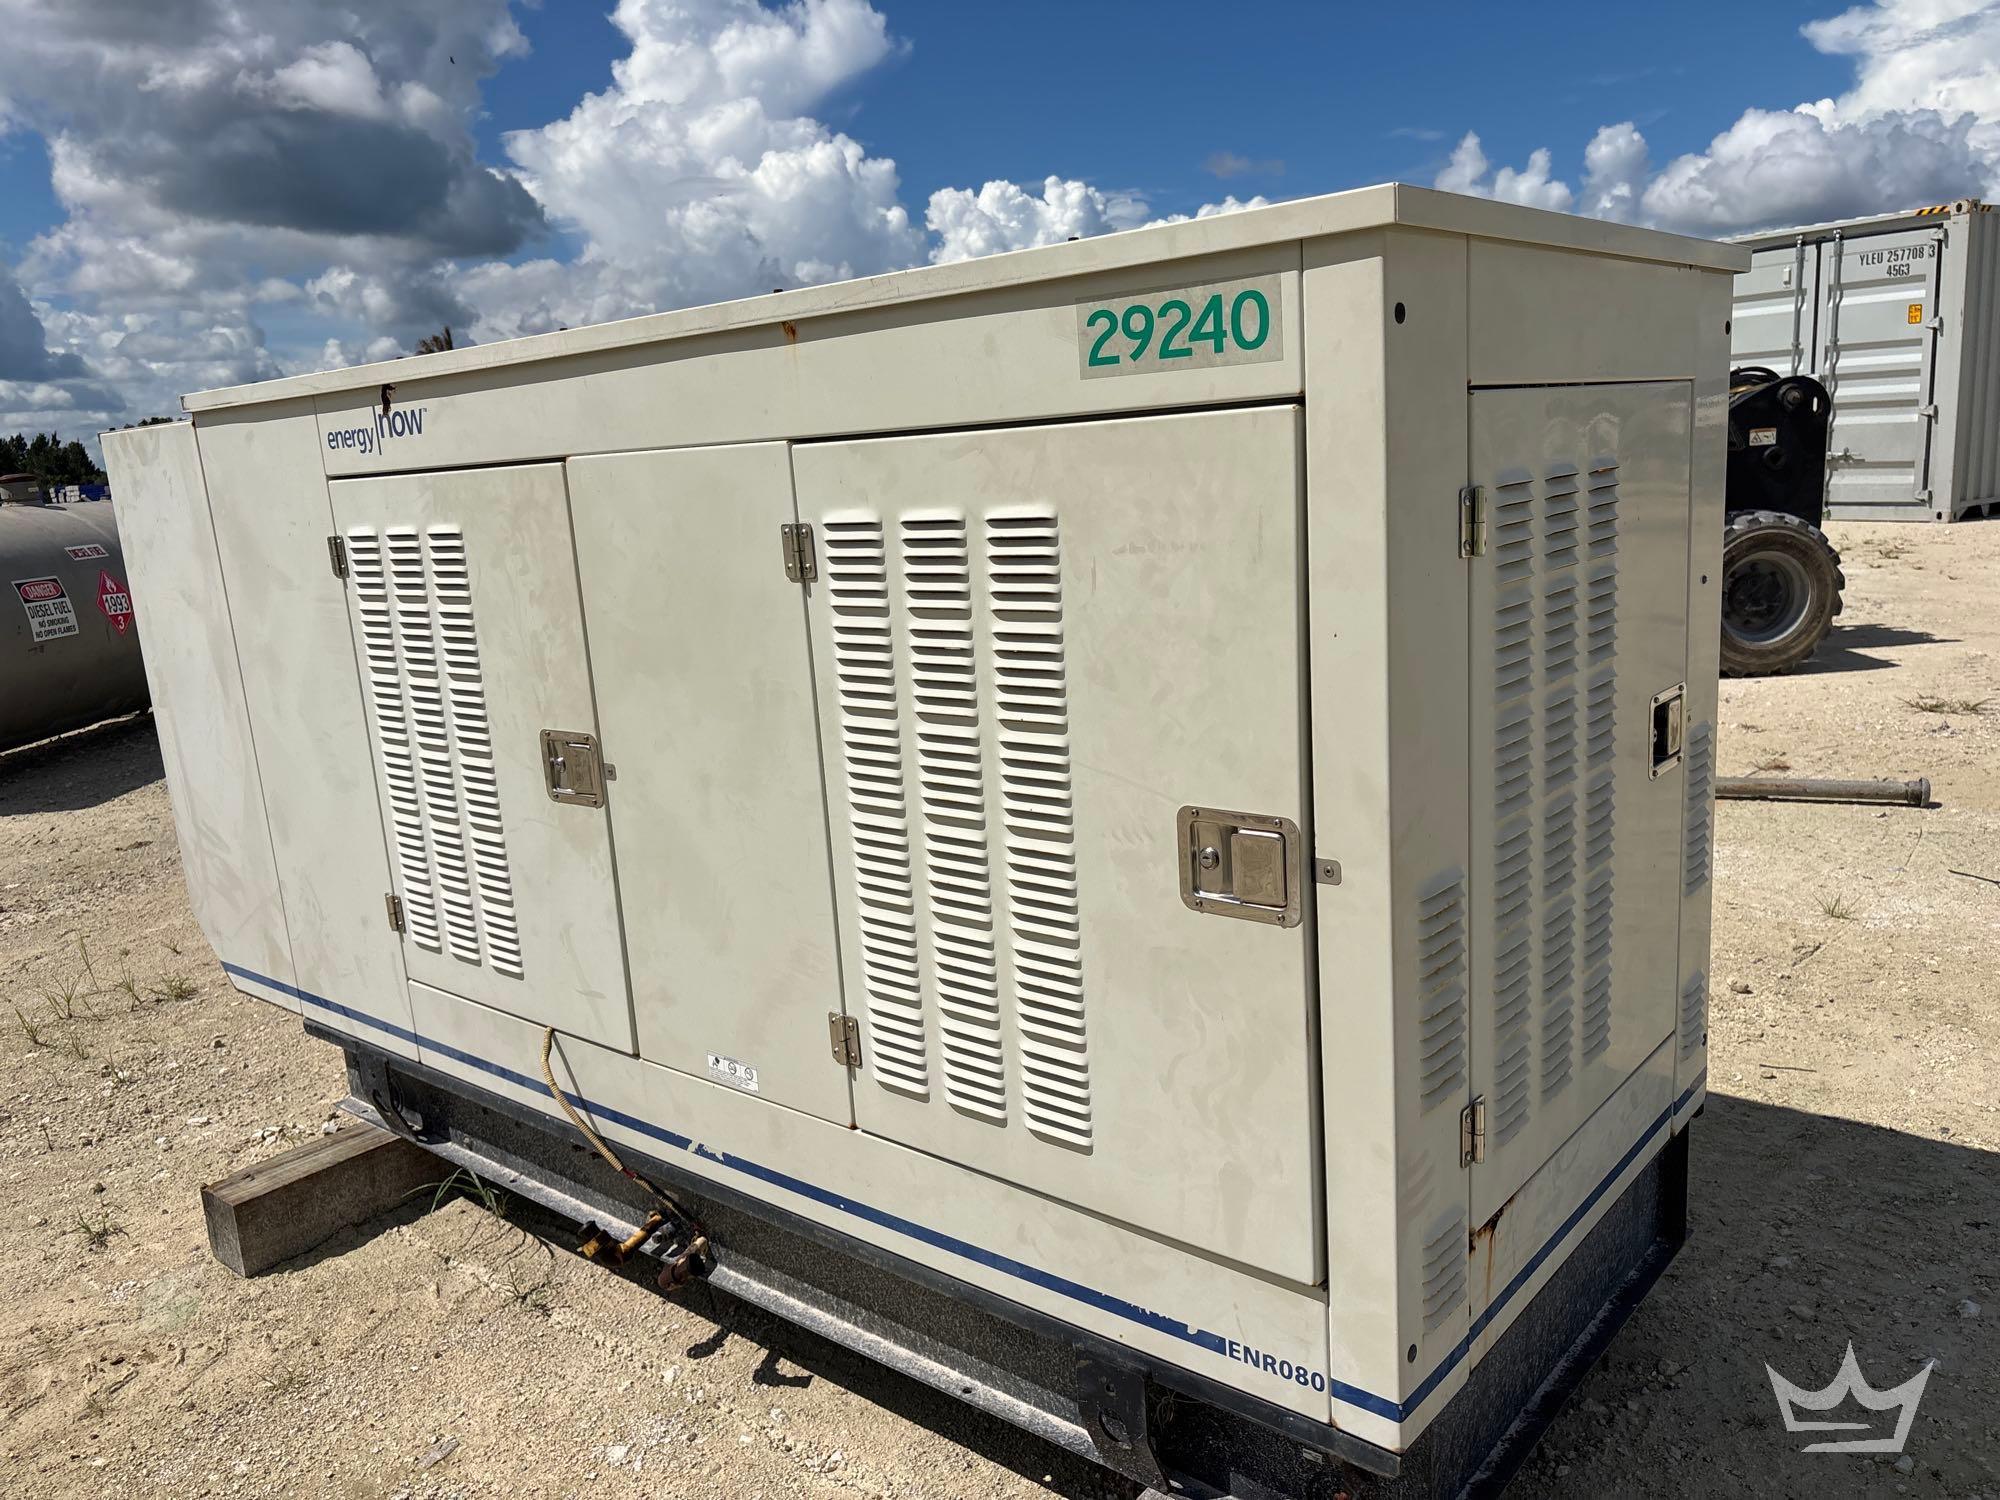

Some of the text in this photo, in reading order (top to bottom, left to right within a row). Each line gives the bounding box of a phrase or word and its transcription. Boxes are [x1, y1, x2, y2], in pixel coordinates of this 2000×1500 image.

[1860, 245, 1935, 266] YLEU 257708 3
[1086, 289, 1270, 367] 29240
[327, 427, 374, 454] energy
[25, 584, 57, 598] DANGER
[28, 600, 72, 619] DIESEL FUEL
[105, 595, 130, 613] 1993
[38, 616, 69, 628] NO SMOKING
[118, 616, 125, 629] 3
[35, 625, 76, 639] NO OPEN FLAMES
[1228, 1339, 1326, 1393] ENR080
